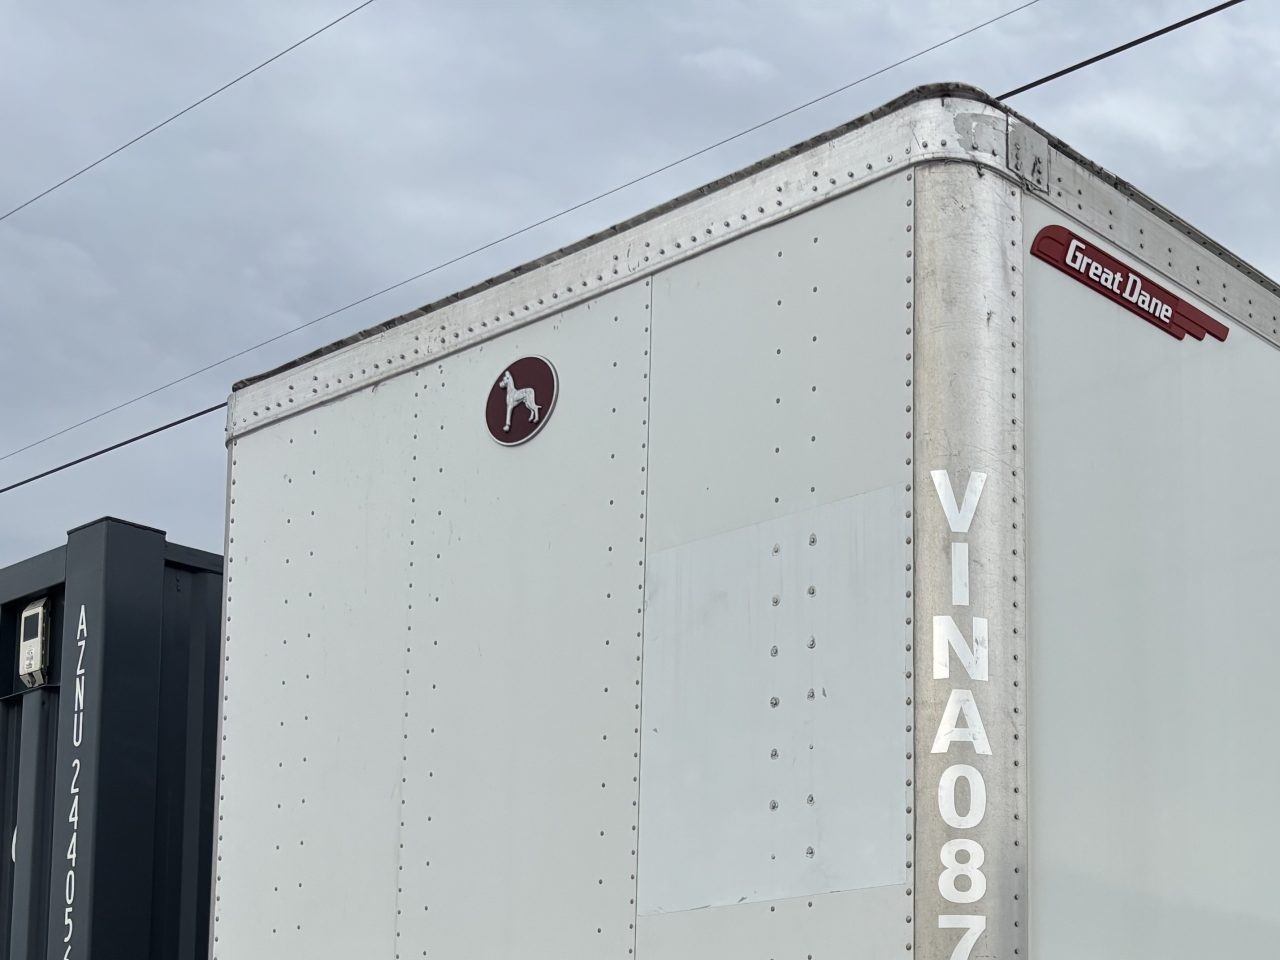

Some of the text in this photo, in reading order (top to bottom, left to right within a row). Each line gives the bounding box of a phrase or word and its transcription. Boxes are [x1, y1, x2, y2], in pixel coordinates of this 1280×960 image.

[1065, 239, 1172, 323] Great Dane
[72, 604, 87, 747] AZNU
